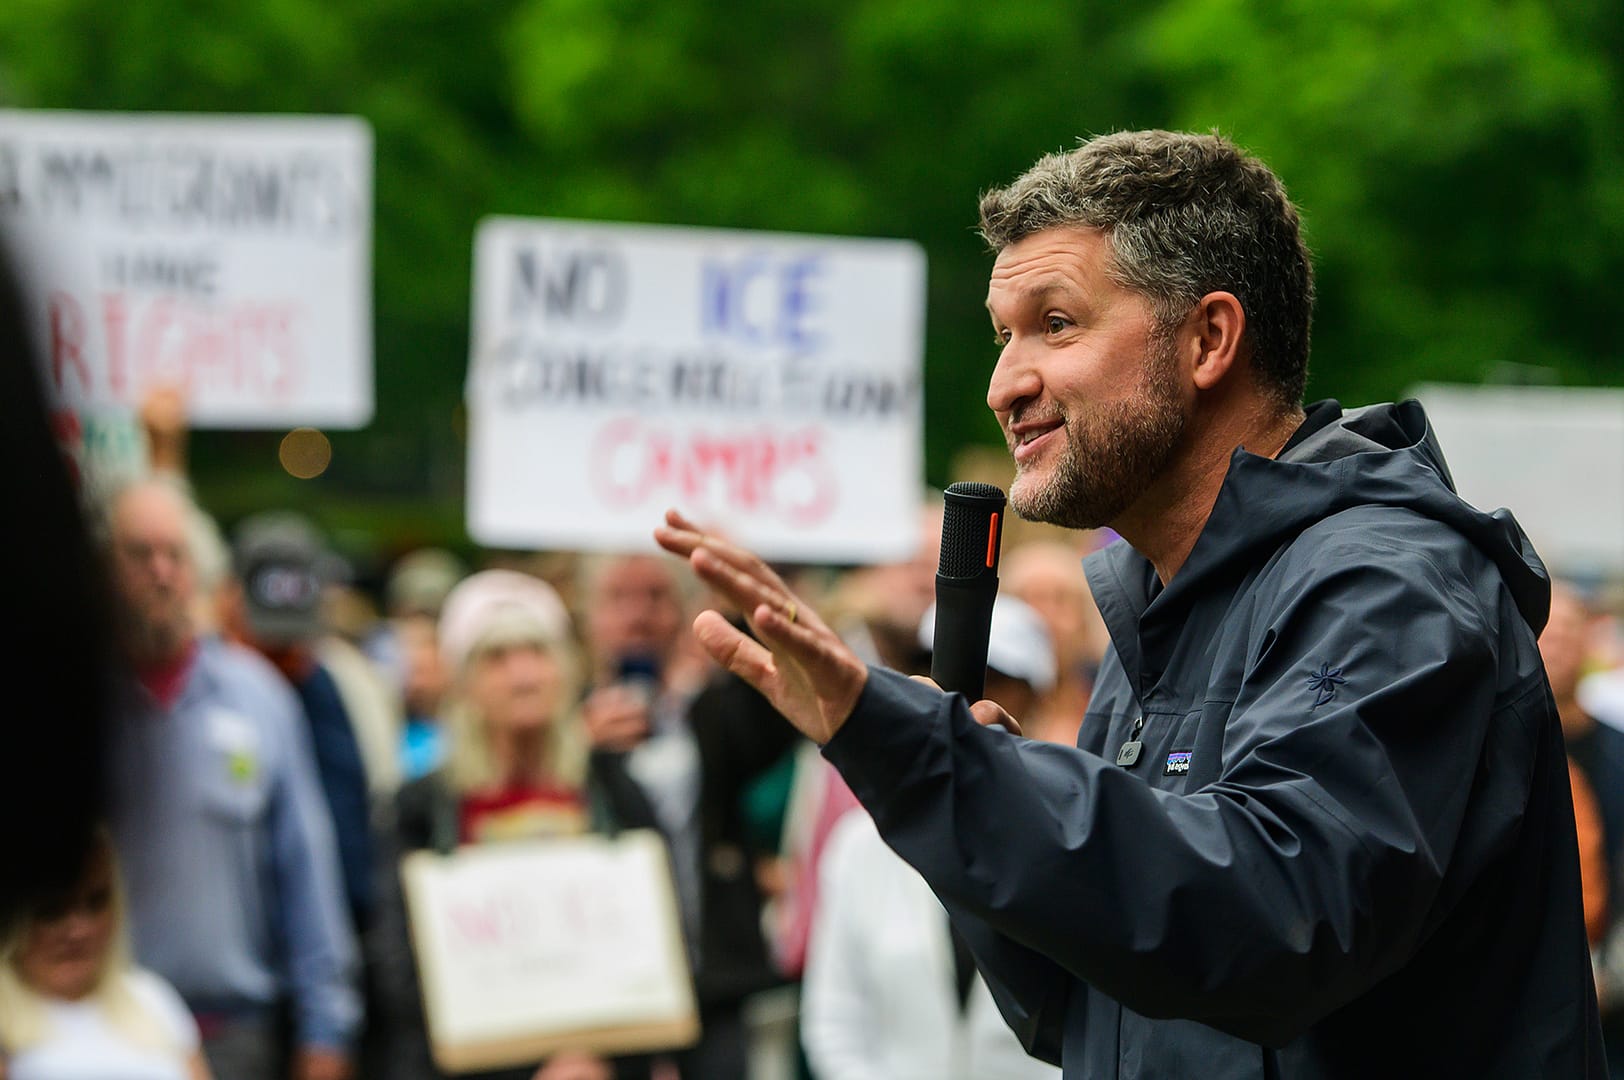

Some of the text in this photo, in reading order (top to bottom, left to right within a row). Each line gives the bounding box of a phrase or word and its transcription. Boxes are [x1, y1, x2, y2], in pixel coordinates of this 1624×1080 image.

[505, 244, 833, 352] NO ICE
[588, 414, 838, 530] CAMPS
